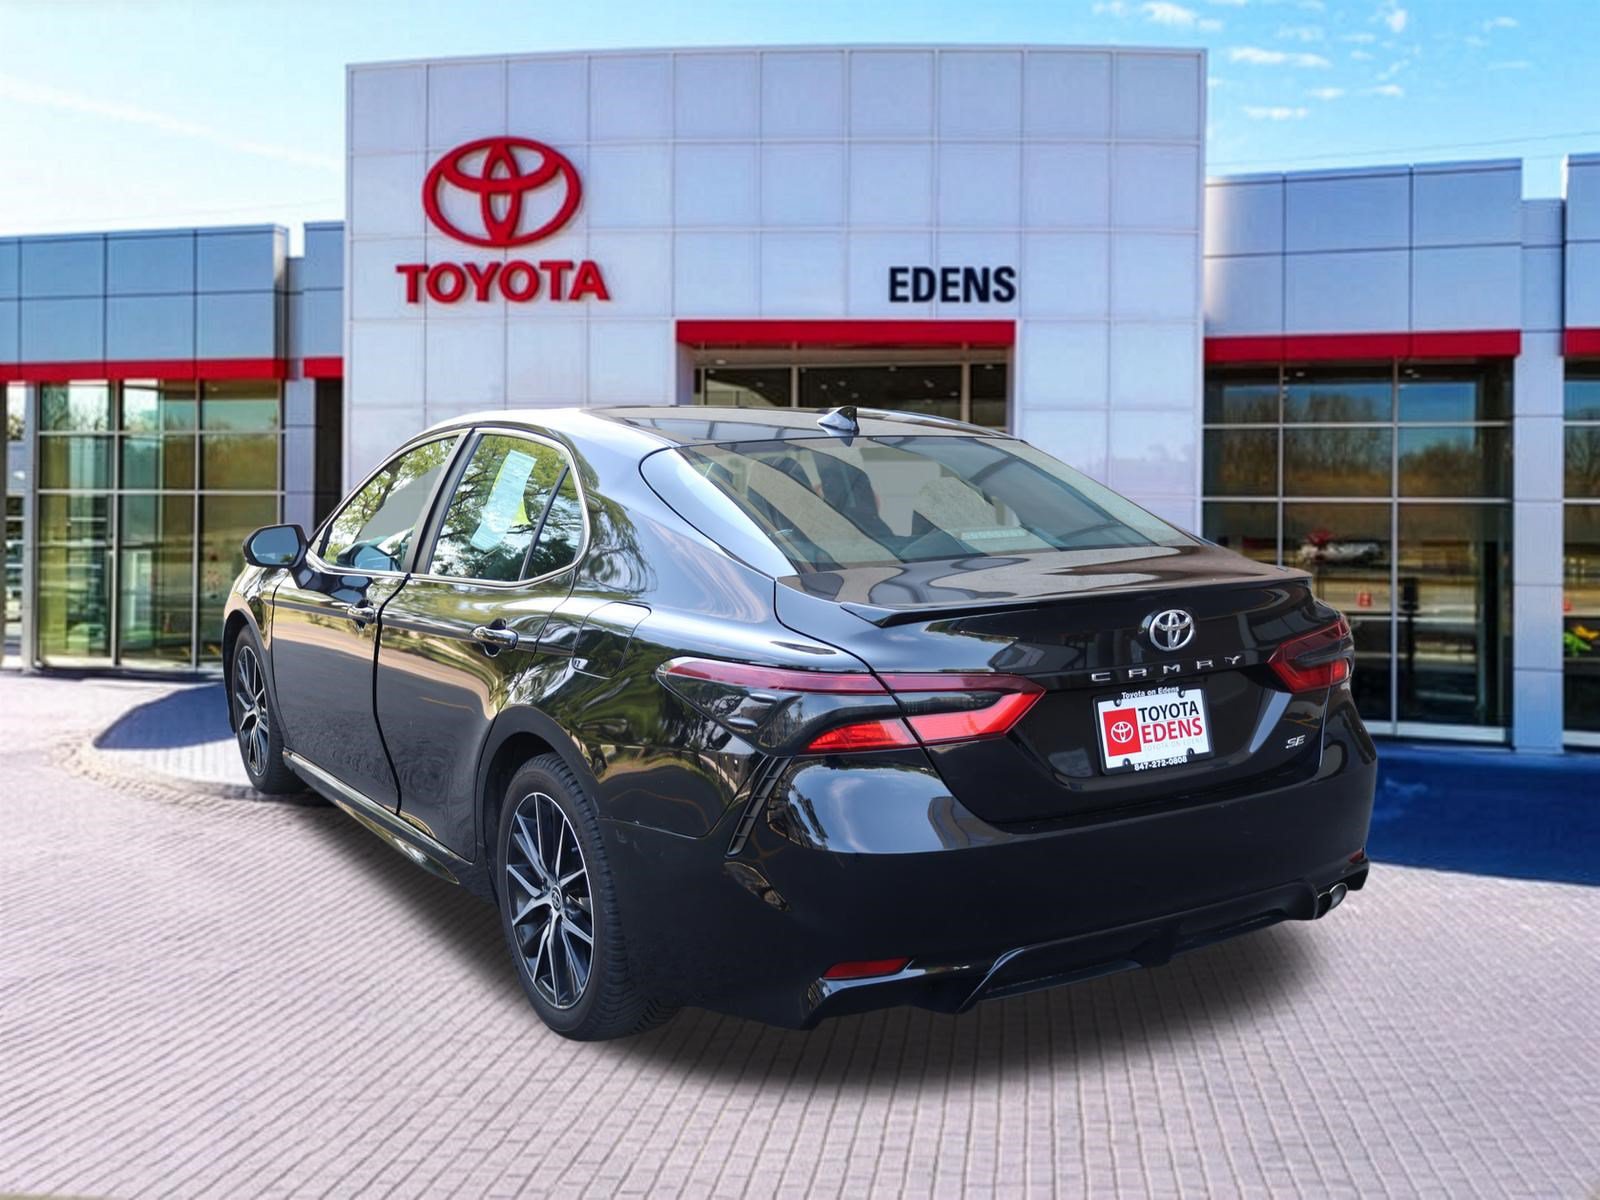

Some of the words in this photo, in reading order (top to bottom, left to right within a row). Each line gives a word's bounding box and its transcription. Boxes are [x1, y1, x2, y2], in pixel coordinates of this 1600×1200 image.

[396, 259, 610, 304] TOYOTA
[889, 266, 1017, 303] EDENS
[1091, 655, 1241, 682] CAMRY
[1121, 689, 1146, 700] Toyota
[1158, 686, 1180, 695] Edens
[1138, 700, 1200, 723] TOYOTA
[1141, 717, 1203, 744] EDENS
[1285, 734, 1306, 749] SE
[1134, 755, 1188, 771] 847-272-0808
